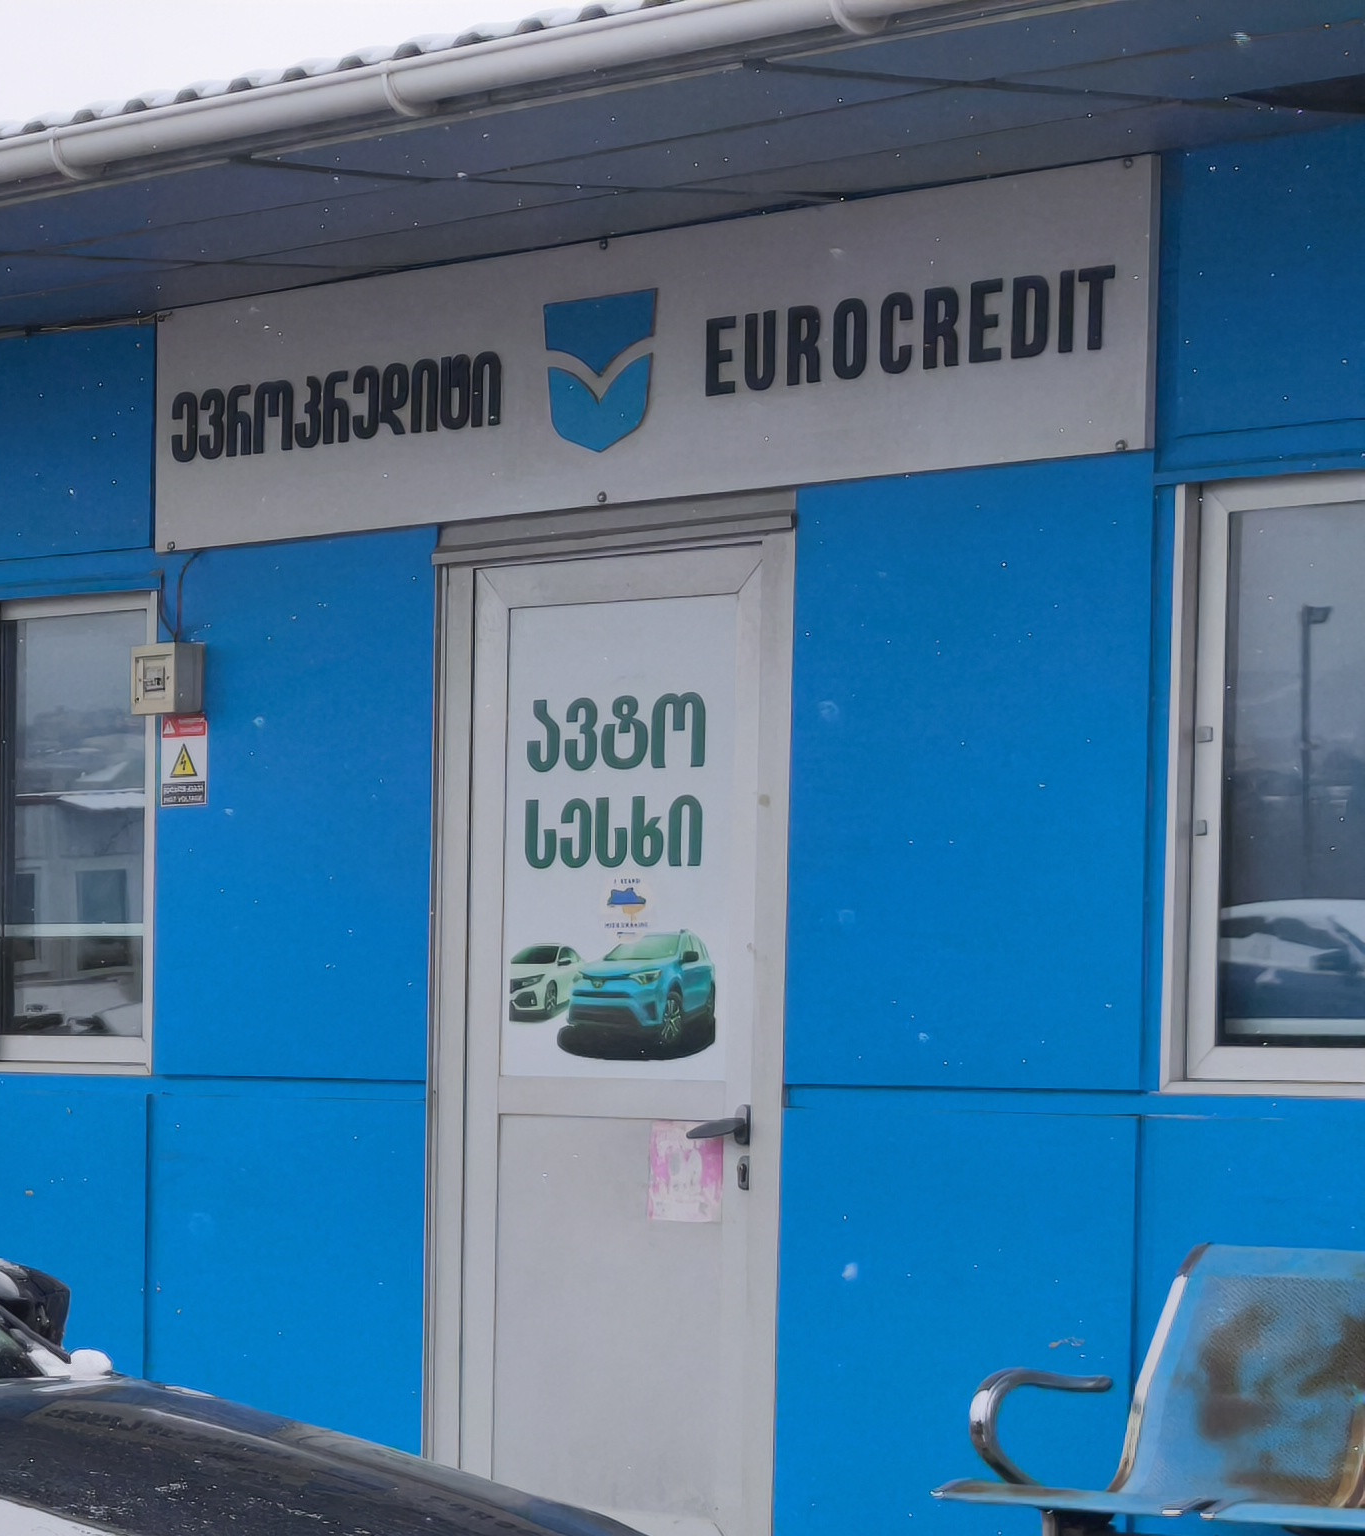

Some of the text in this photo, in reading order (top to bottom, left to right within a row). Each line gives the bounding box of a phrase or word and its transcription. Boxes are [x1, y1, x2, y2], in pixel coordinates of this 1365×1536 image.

[704, 263, 1117, 397] EUROCREDIT
[171, 351, 502, 463] ევროკრედიტი
[526, 691, 707, 773] ავტო
[524, 794, 703, 869] სესხი
